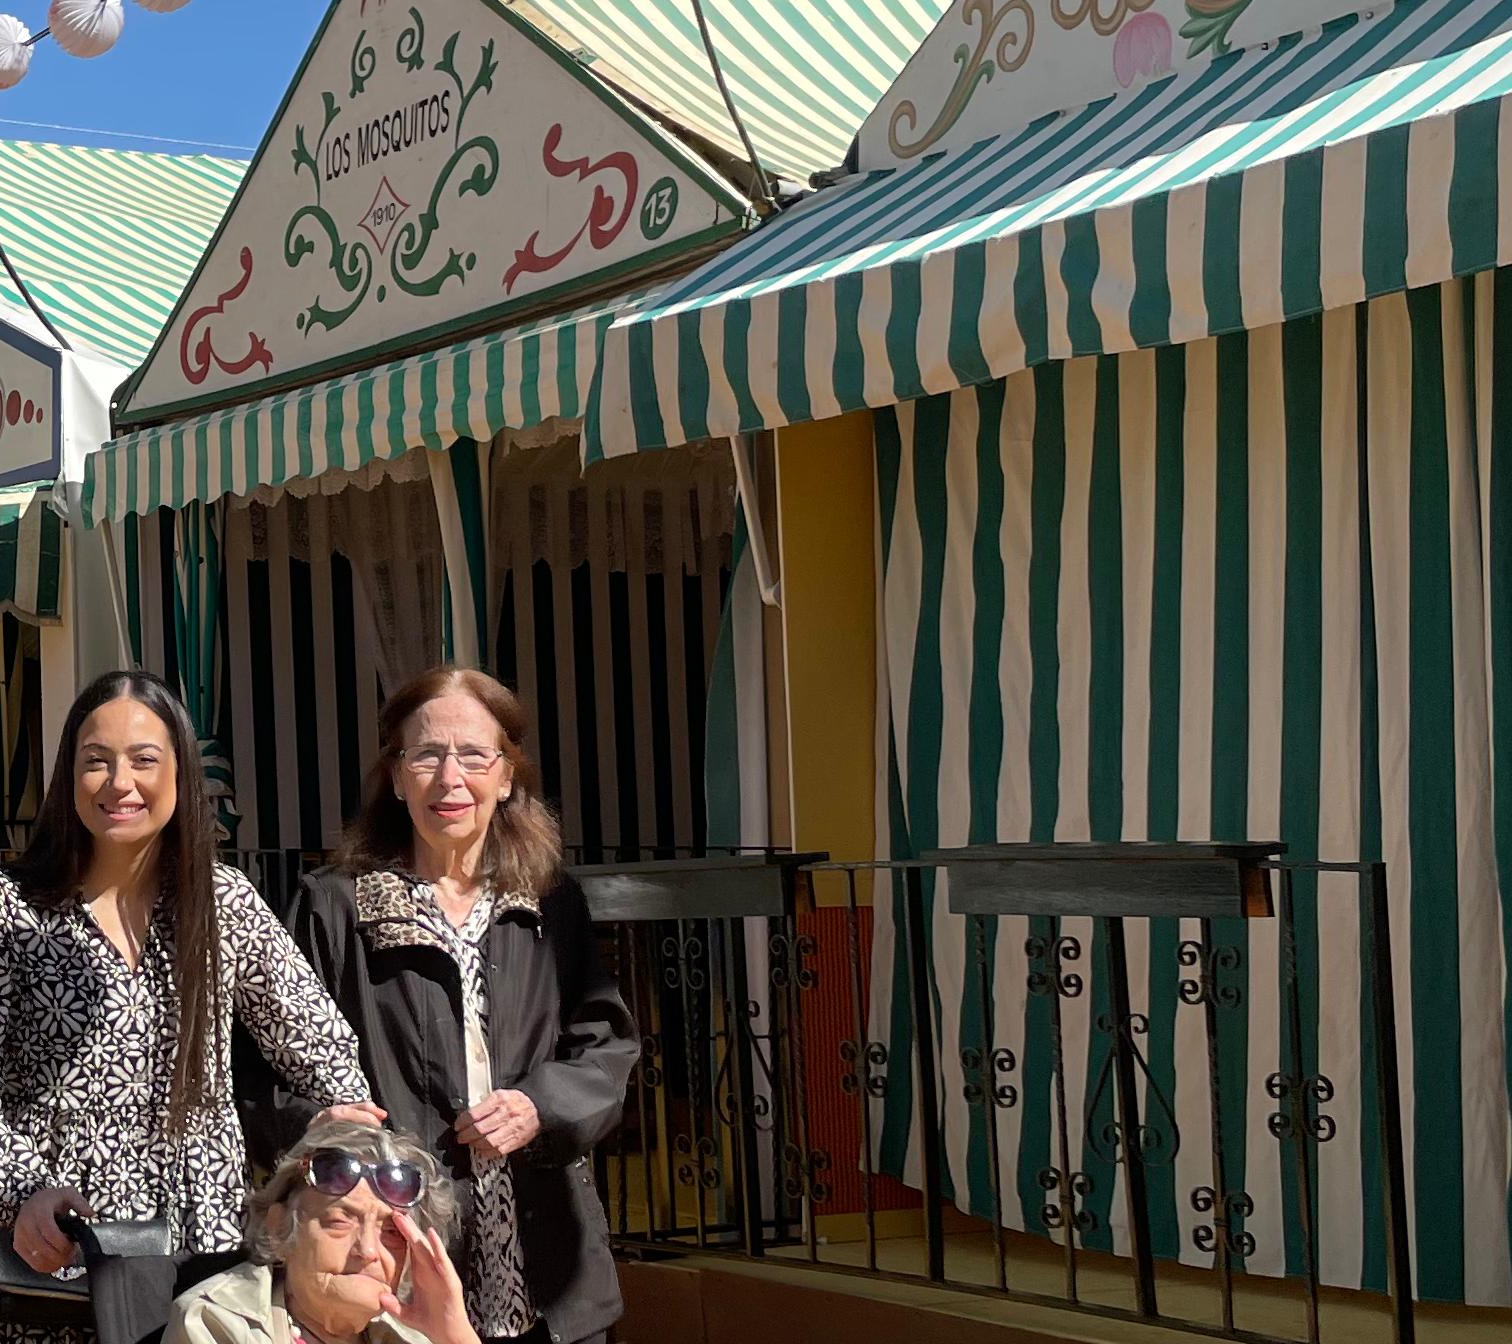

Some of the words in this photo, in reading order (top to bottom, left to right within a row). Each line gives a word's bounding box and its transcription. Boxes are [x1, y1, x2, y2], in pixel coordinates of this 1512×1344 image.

[325, 132, 351, 182] LOS
[357, 89, 450, 169] MOSQUITOS
[370, 202, 396, 227] 1910
[645, 186, 673, 228] 13
